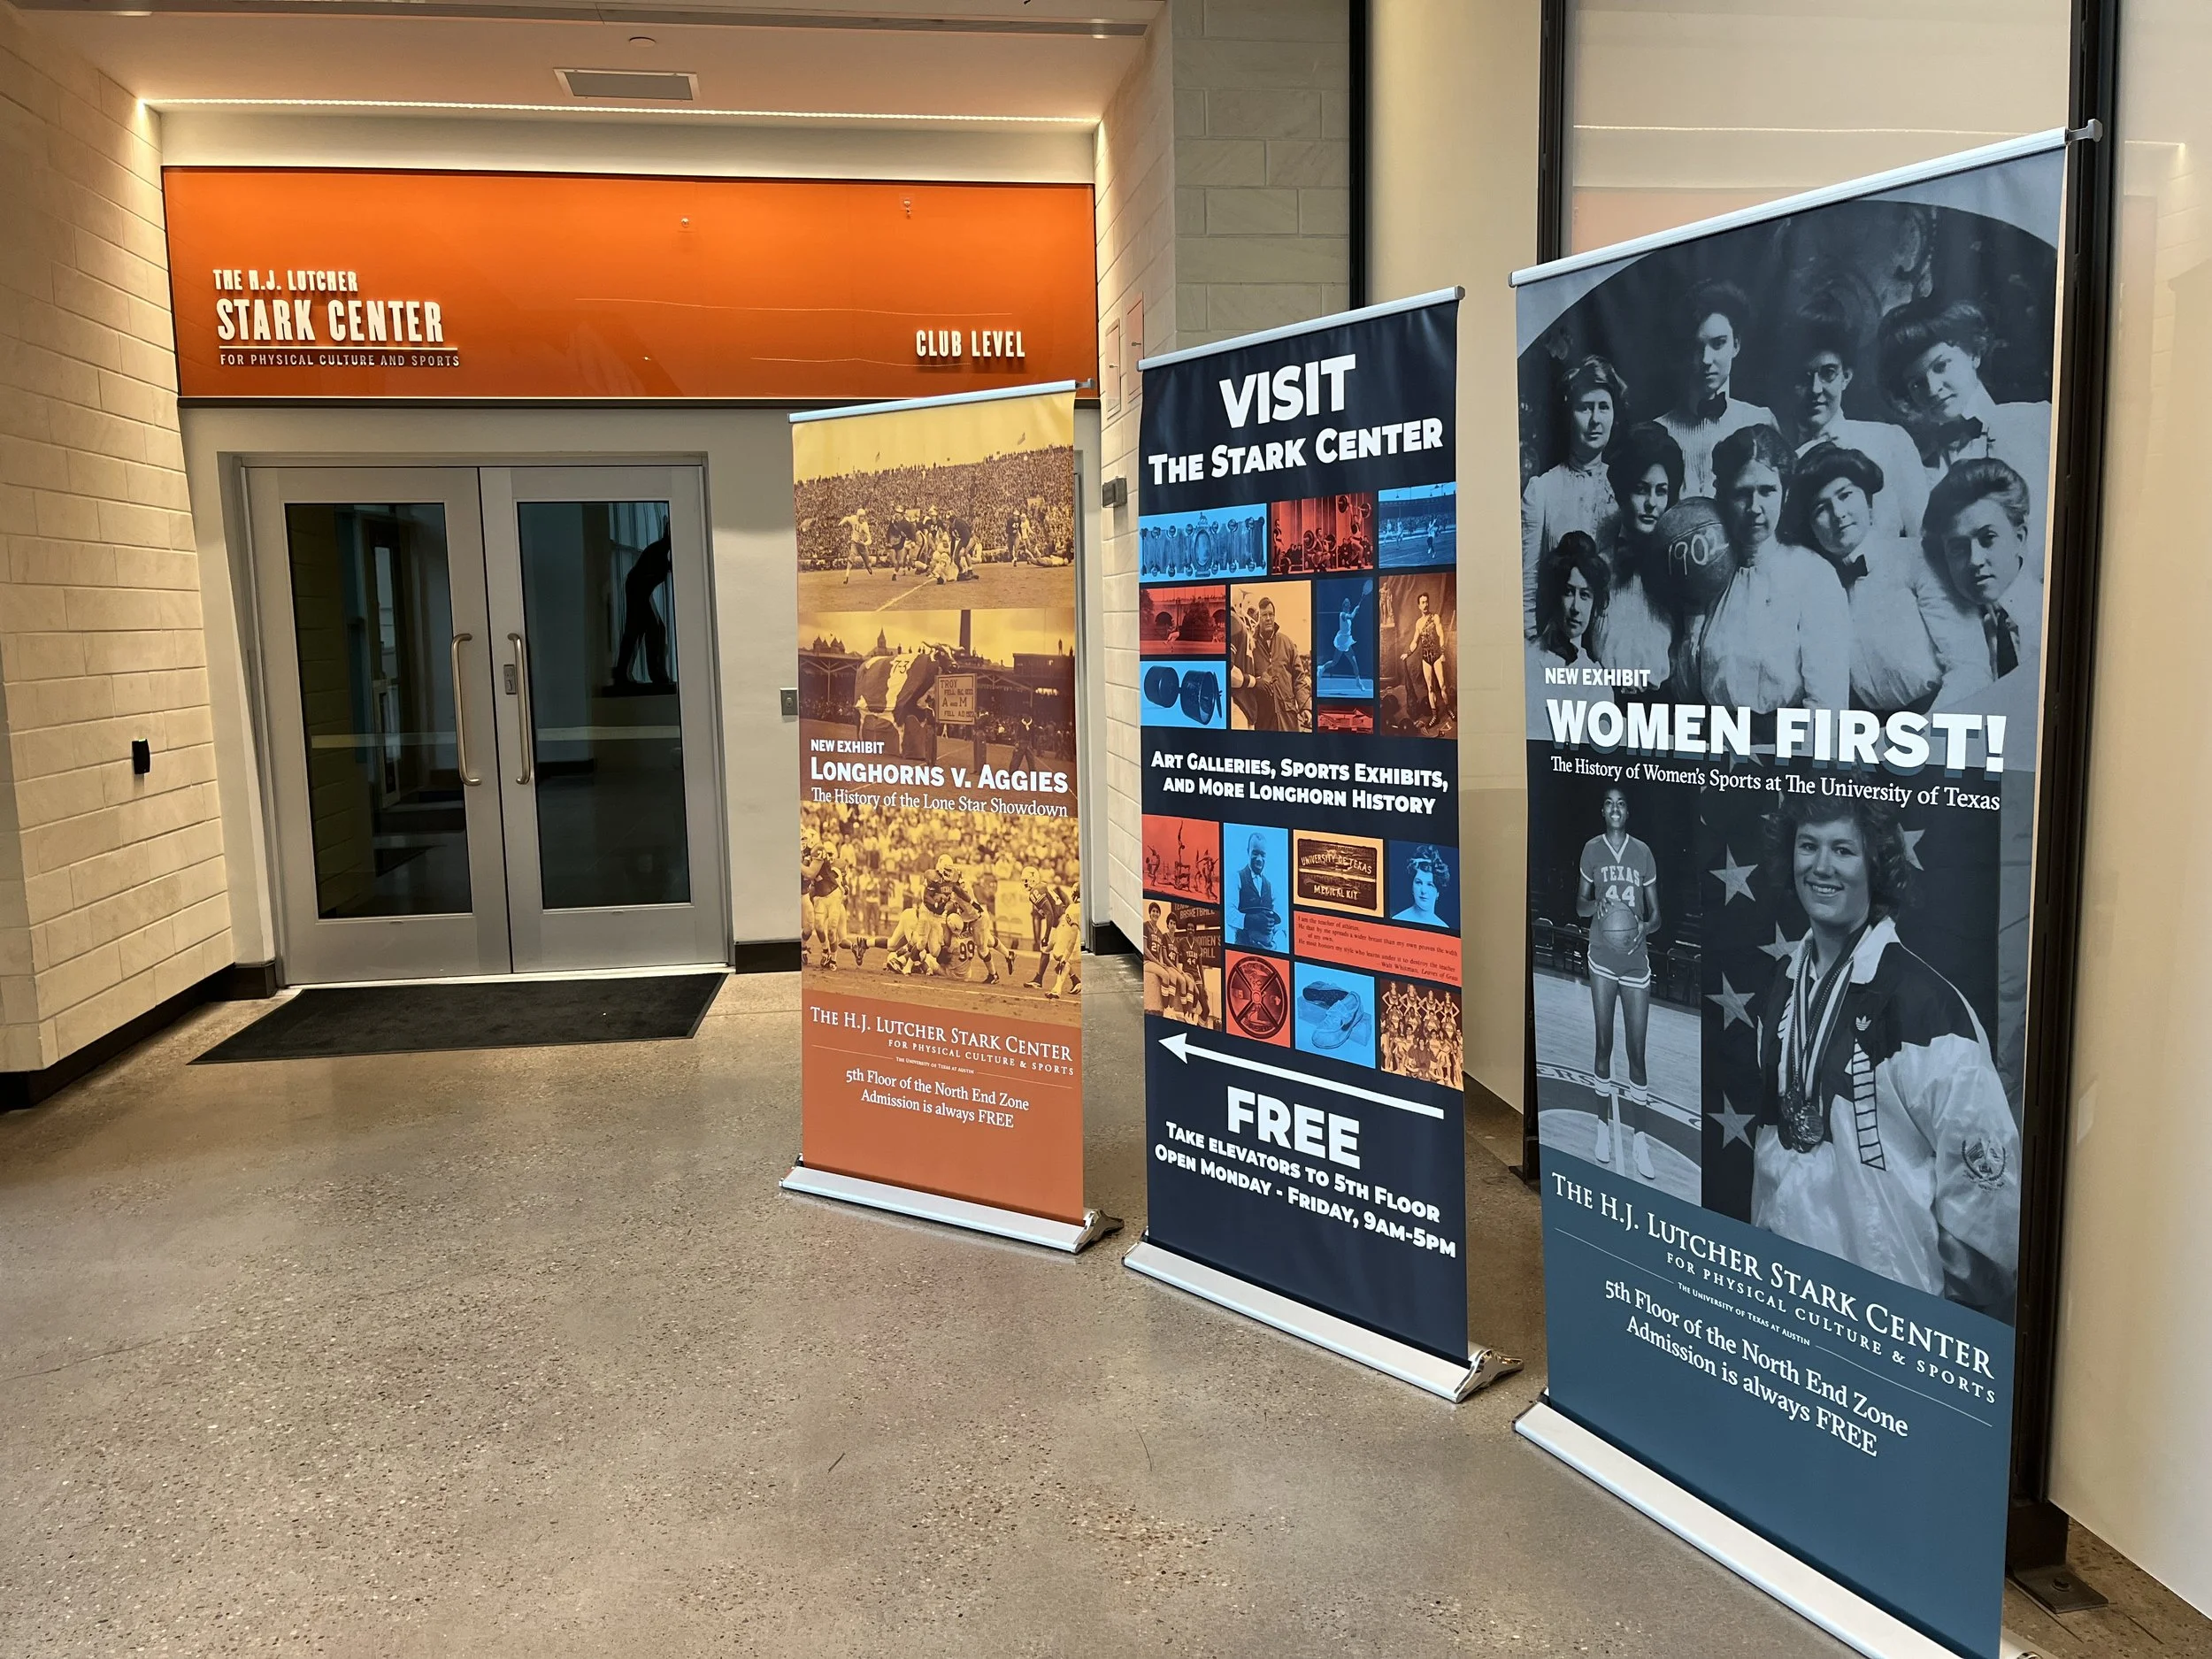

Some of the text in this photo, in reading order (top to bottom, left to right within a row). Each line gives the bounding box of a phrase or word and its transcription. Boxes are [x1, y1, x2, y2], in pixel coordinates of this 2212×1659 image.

[213, 270, 358, 292] THE H.J. LUTCHER
[217, 299, 443, 342] STARK CENTER
[220, 355, 460, 366] FOR PHYSICAL CULTURE AND SPORTS
[917, 330, 1025, 357] CLUB LEVEL
[1219, 354, 1356, 429] VISIT
[1148, 418, 1443, 485] THE STARK CENTER
[941, 680, 957, 688] TROY
[1545, 667, 1650, 687] NEW EXHIBIT
[942, 697, 966, 707] A M
[811, 739, 884, 754] NEW EXHIBIT
[1546, 698, 2007, 772] WOMEN FIRST!
[811, 757, 1068, 793] LONGHORNS V. AGGIES
[1151, 750, 1448, 793] ART GALLERIES, SPORTS EXHIBITS,
[1551, 757, 2001, 810] The History of Women's Sports at The University of Texas
[811, 787, 1068, 817] The History of the Lone Star Showdown
[1163, 778, 1436, 815] AND MORE LONGHORN HISTORY
[1301, 854, 1335, 865] UNIVERSITY
[1348, 858, 1371, 874] TEXAS
[1601, 866, 1640, 887] TEXAS
[1314, 885, 1357, 900] MEDICAL KIT
[1606, 885, 1635, 907] 44
[958, 941, 974, 962] 99
[810, 1006, 1072, 1062] THE H.J. LUTCHER STARK CENTER
[888, 1040, 908, 1049] FOR
[913, 1042, 960, 1058] PHYSICAL
[965, 1051, 1015, 1066] CULTURE
[1032, 1063, 1074, 1076] SPORTS
[846, 1068, 1029, 1110] 5th Floor of the North End Zone
[861, 1089, 1014, 1128] Admission is always FREE
[1227, 1086, 1361, 1170] FREE
[1166, 1121, 1440, 1223] TAKE ELEVATORS TO 5TH FLOOR
[1155, 1144, 1196, 1172] OPEN
[1201, 1158, 1271, 1196] MONDAY
[1287, 1187, 1360, 1229] FRIDAY,
[1363, 1210, 1456, 1258] 9AM-5PM
[1552, 1172, 1994, 1379] THE H.J. LUTCHER STARK CENTER
[1667, 1252, 1995, 1404] FOR PHYSICAL CULTURE & SPORTS
[1678, 1282, 1691, 1294] THE
[1693, 1289, 1733, 1311] UNIVERSITY
[1747, 1312, 1769, 1327] TEXAS
[1782, 1328, 1810, 1346] AUSTIN
[1605, 1279, 1909, 1438] 5th Floor of the North End Zone
[1626, 1315, 1878, 1458] Admission is always FREE
